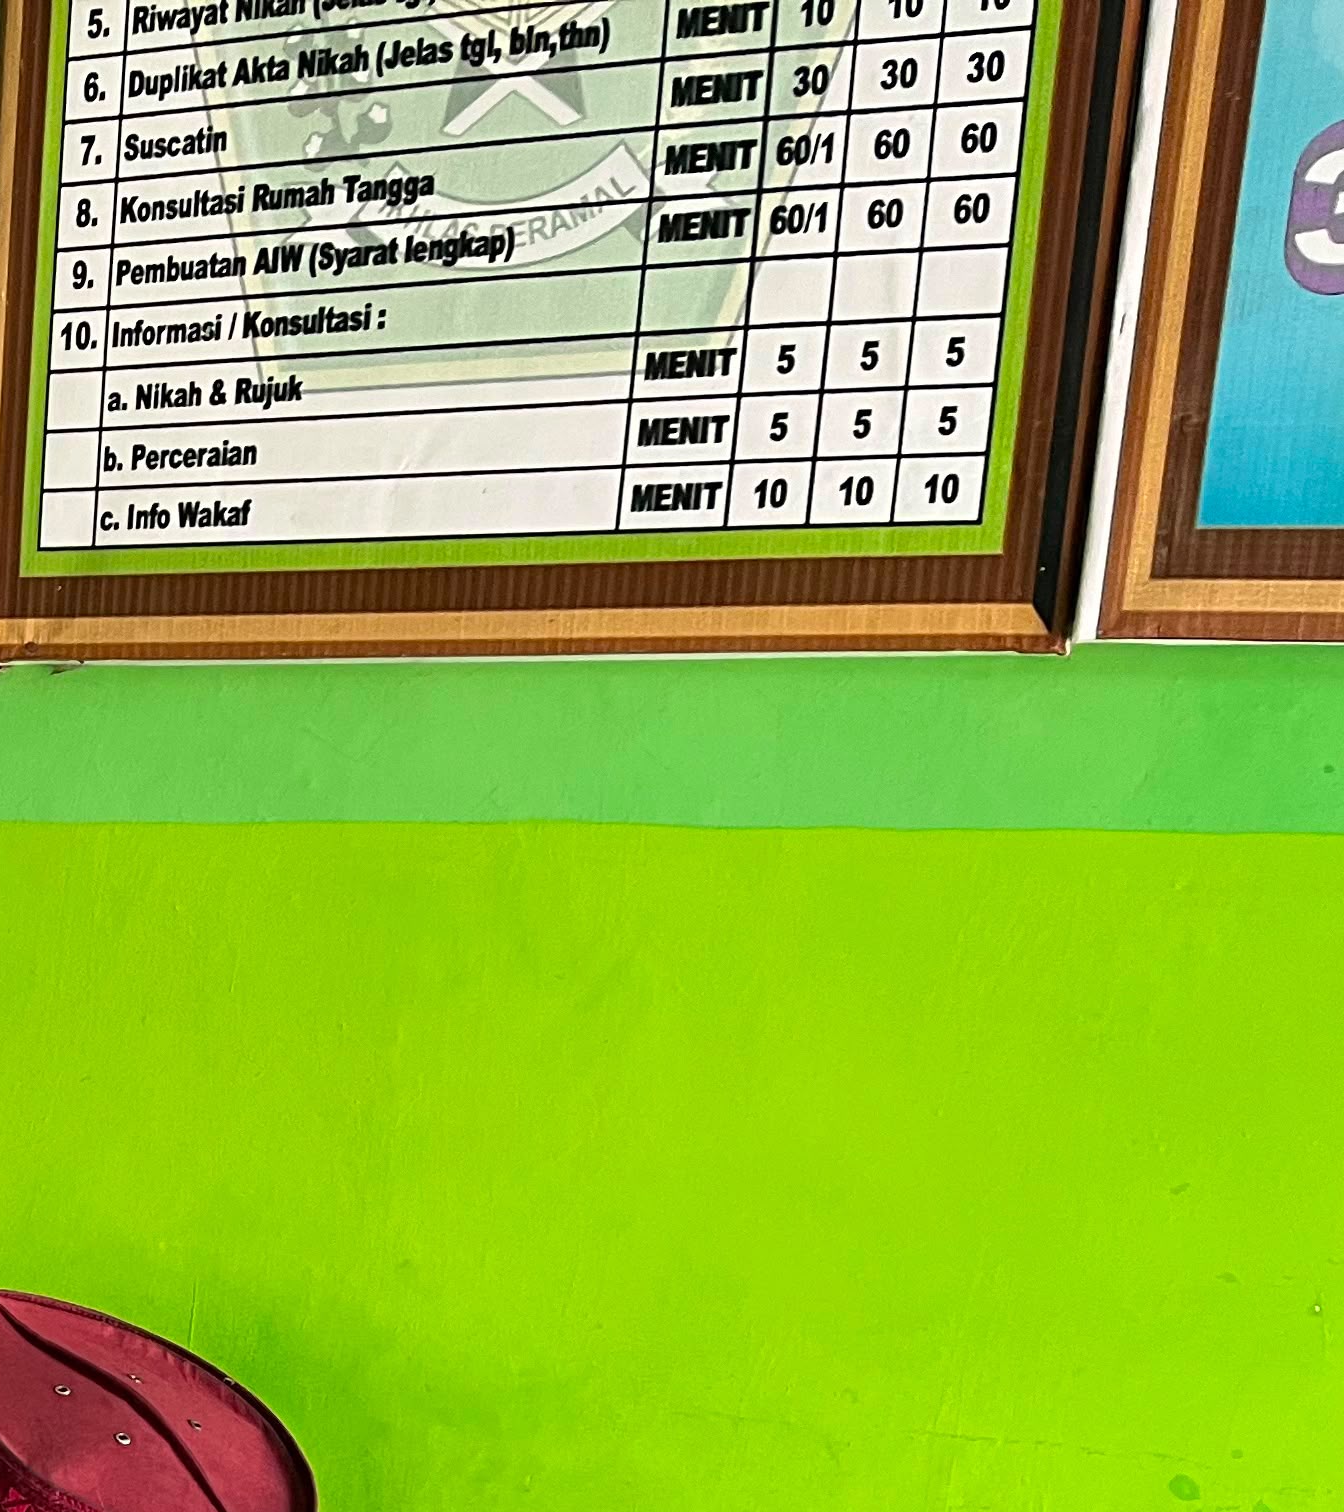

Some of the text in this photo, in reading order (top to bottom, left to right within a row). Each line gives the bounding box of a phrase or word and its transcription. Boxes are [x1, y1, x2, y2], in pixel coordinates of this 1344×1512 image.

[83, 71, 106, 103] 6.
[128, 60, 228, 102] Duplikat
[231, 55, 290, 87] Akta
[297, 43, 370, 80] Nikah
[375, 37, 454, 78] (Jelas
[460, 29, 502, 68] tgl,
[675, 1, 770, 40] MENIT
[800, 0, 835, 28] 10
[87, 14, 112, 39] 5.
[132, 1, 229, 36] Riwayat
[80, 50, 1005, 166] 7. Suscatin MENIT 30 30 30
[75, 121, 998, 228] 8. Konsultasi Rumah Tangga MENIT 60/1 60 60
[72, 192, 990, 290] 9. Pembuatan AIW (Syarat lengkap) MENIT 60/1 60 60
[60, 320, 98, 351] 10.
[111, 313, 223, 348] Informasi
[242, 302, 373, 339] Konsultasi
[107, 336, 966, 412] a. Nikah & Rujuk MENIT 5 5 5
[103, 405, 958, 472] b. Perceraian MENIT 5 5 5
[100, 473, 960, 531] c. Info Wakaf MENIT 10 10 10
